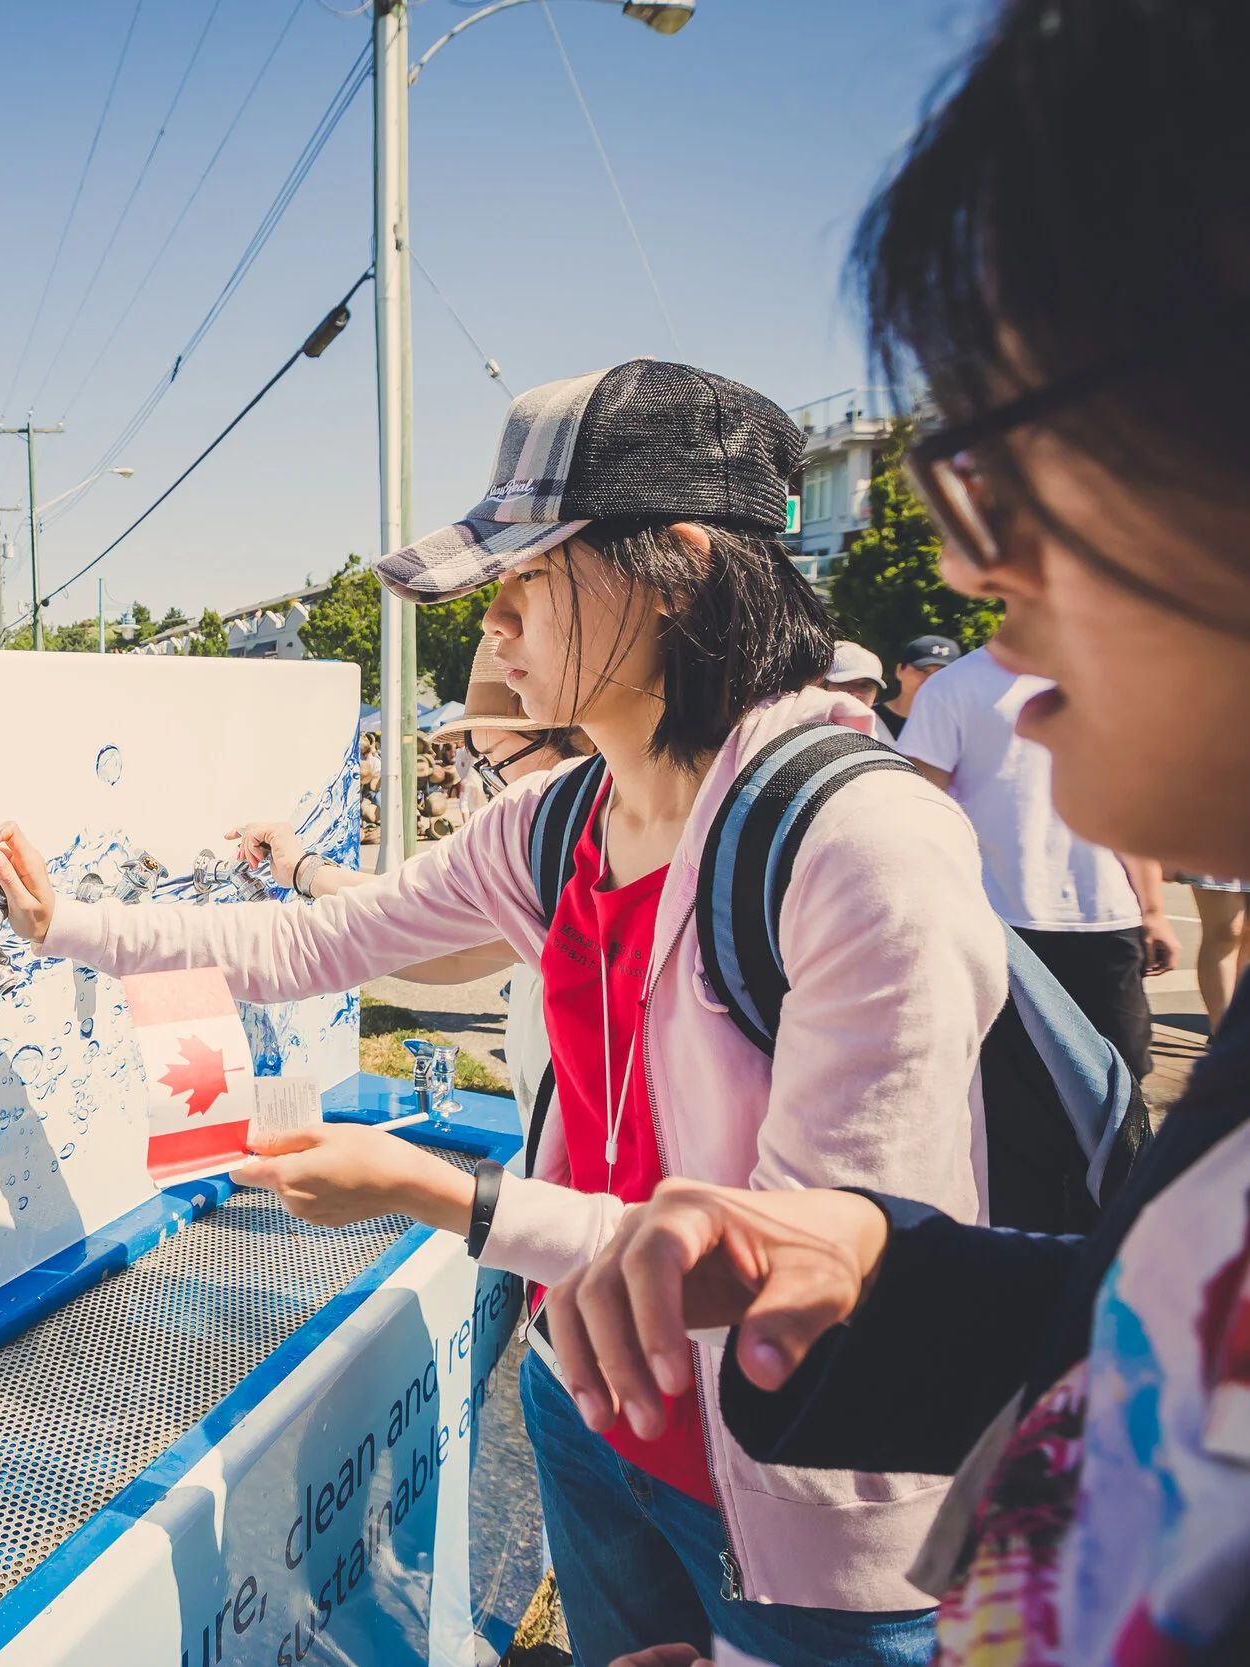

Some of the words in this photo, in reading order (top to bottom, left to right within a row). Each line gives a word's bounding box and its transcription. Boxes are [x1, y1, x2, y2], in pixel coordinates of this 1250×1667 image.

[277, 1425, 449, 1667] sustainable
[285, 1432, 376, 1570] clean
[387, 1338, 440, 1448] and
